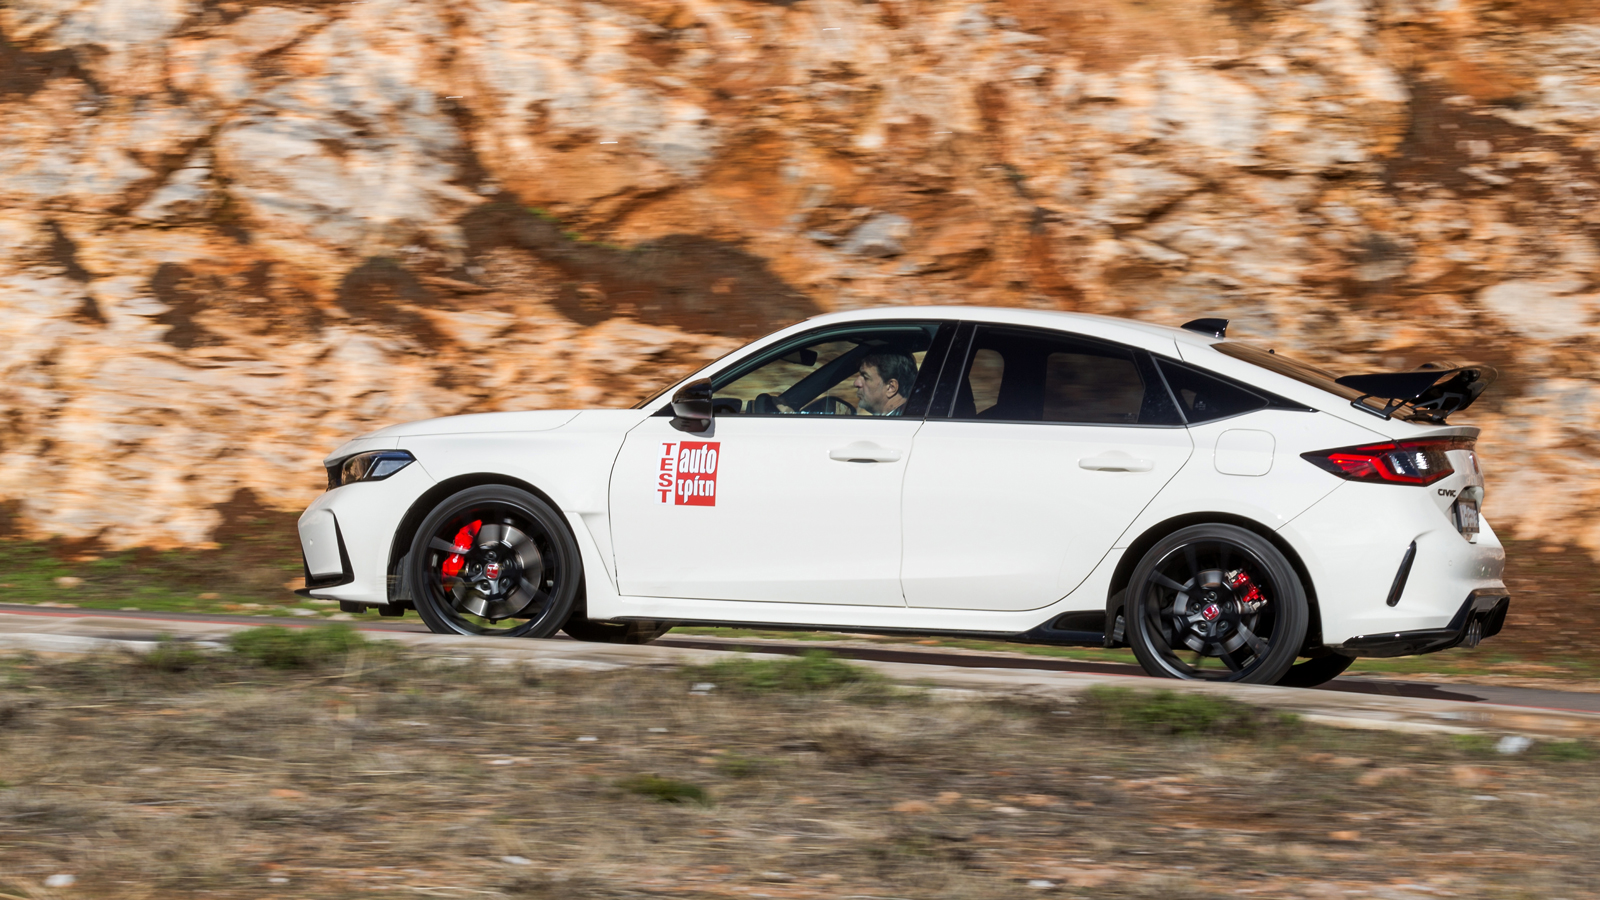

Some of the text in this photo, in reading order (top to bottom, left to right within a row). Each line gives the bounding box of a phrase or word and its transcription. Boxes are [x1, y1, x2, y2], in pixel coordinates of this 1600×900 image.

[657, 442, 677, 503] TEST
[679, 443, 717, 474] auto
[1437, 488, 1457, 498] CIVIC
